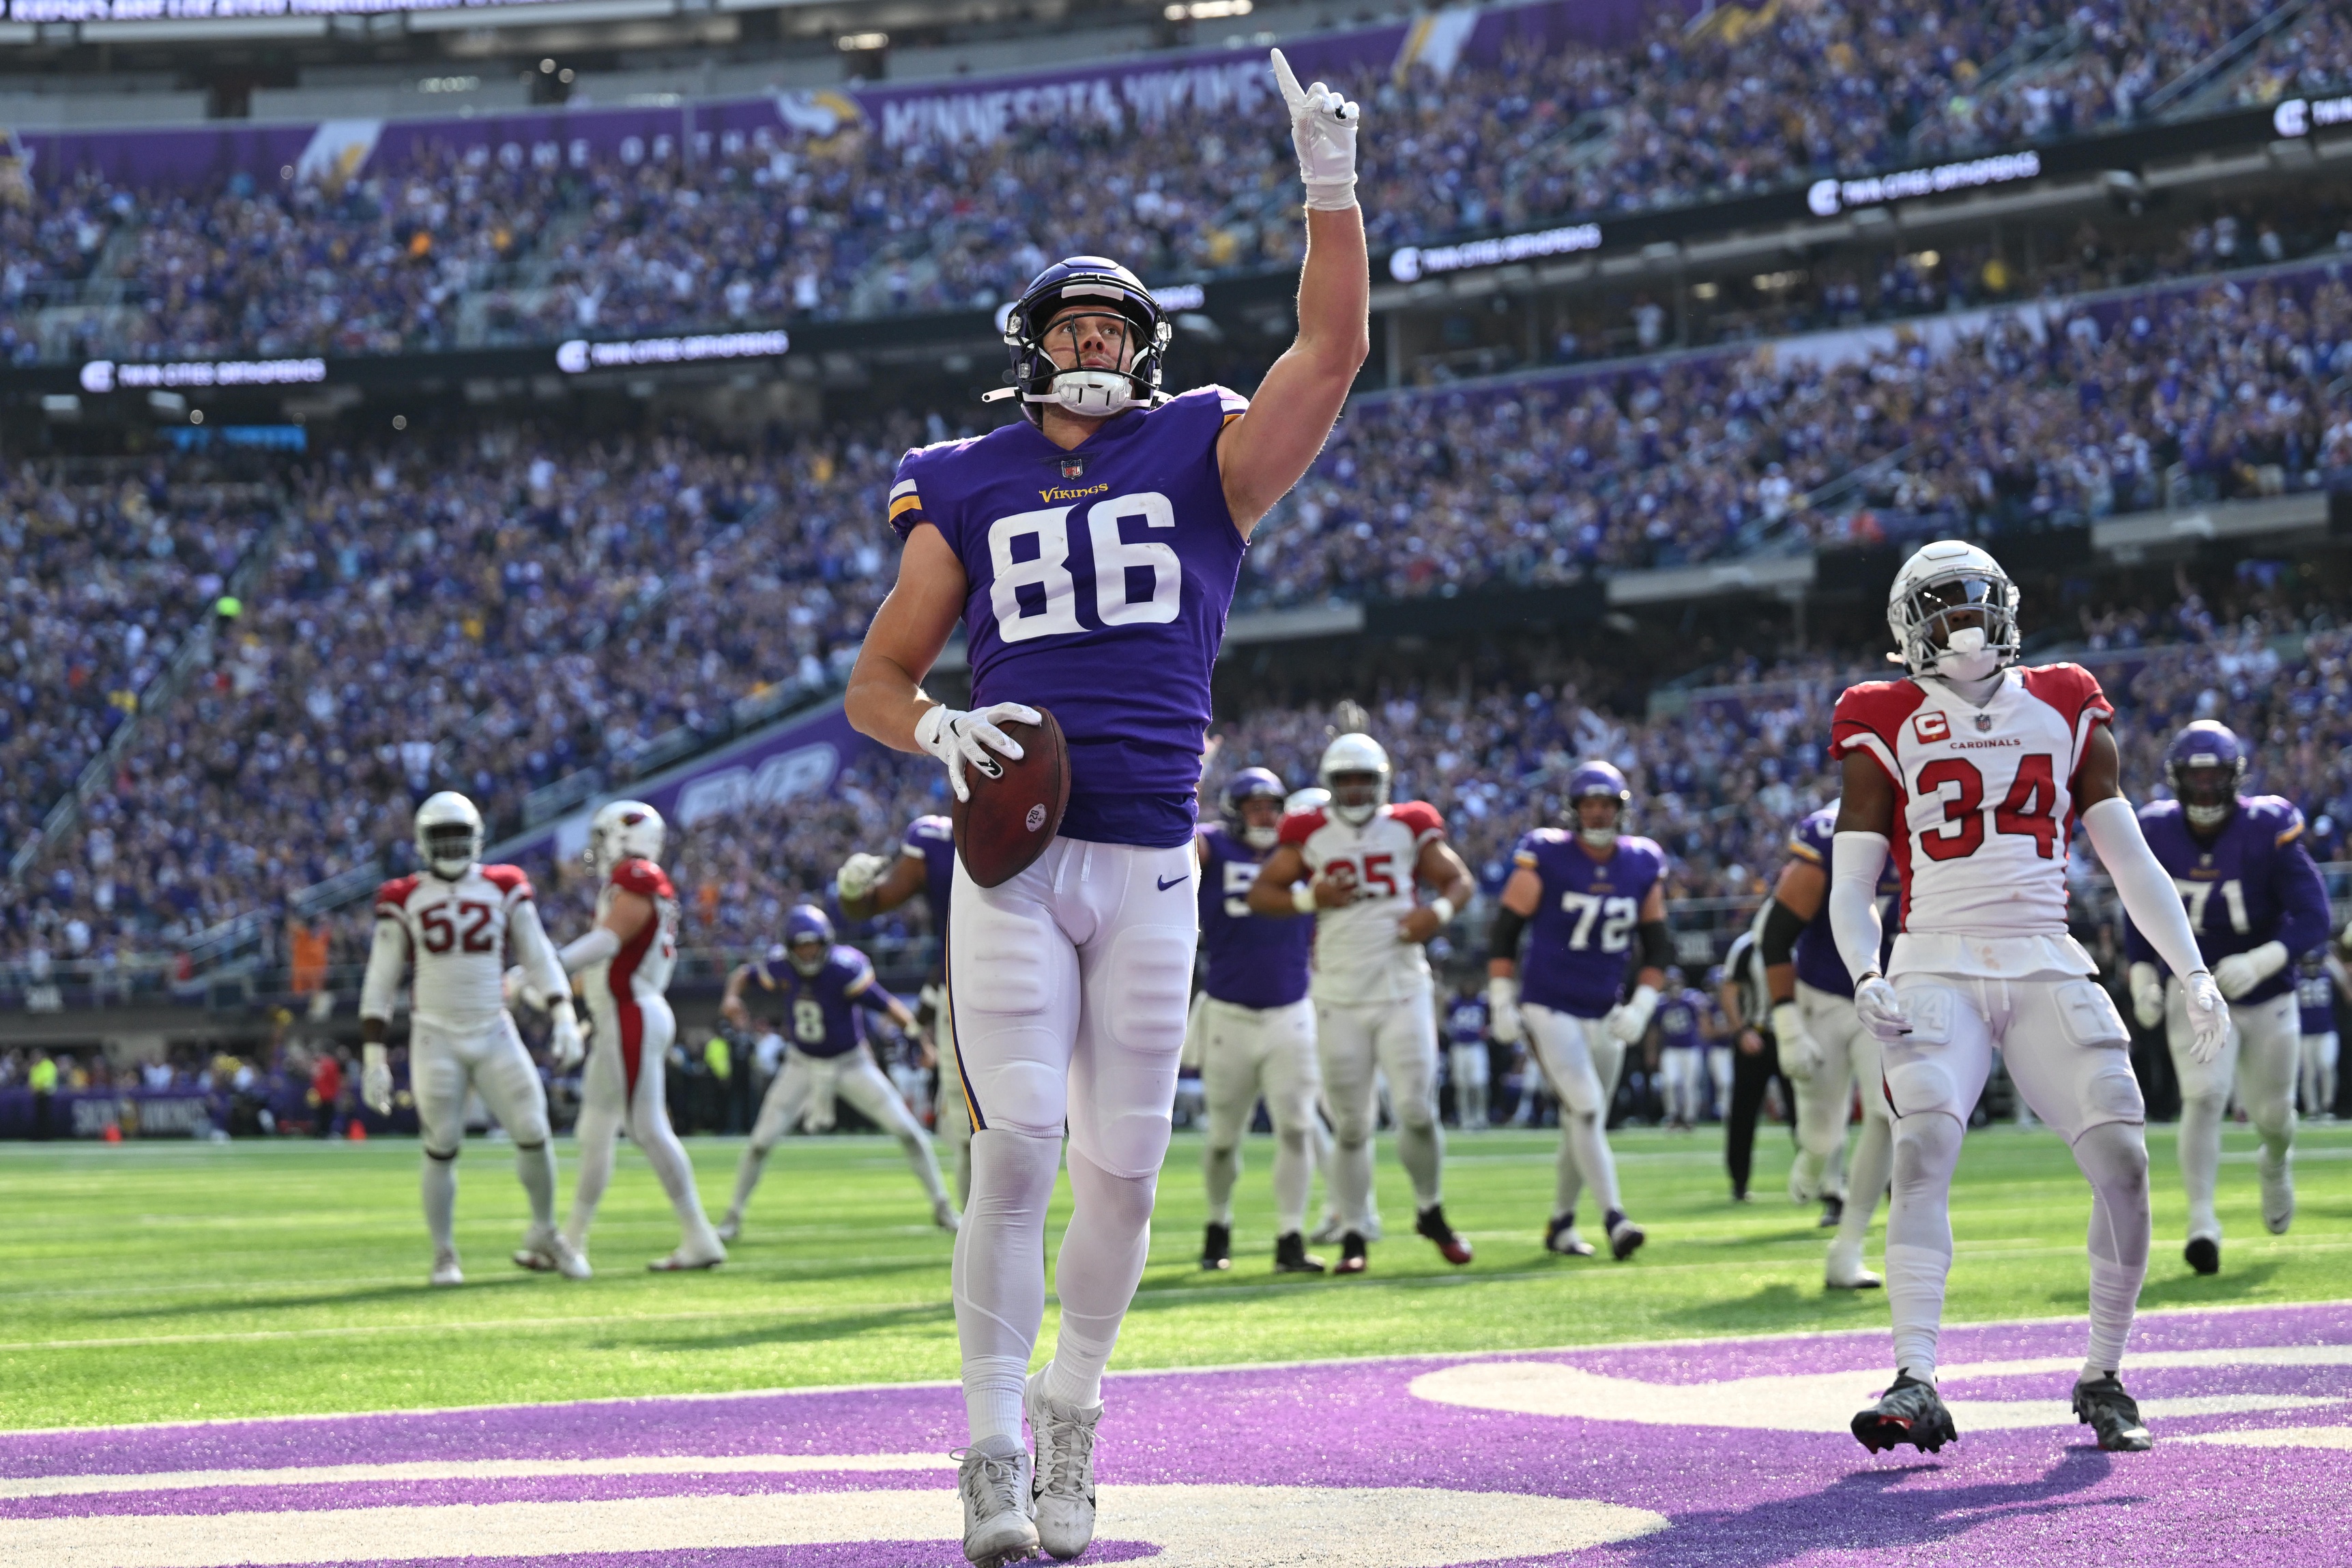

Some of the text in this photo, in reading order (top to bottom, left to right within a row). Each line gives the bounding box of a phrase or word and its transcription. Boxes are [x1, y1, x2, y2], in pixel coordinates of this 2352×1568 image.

[1065, 466, 1080, 476] NFL
[988, 491, 1182, 643] 86
[1915, 712, 1946, 736] C
[1949, 738, 2021, 750] CARDINALS
[1027, 809, 1040, 824] 024
[1916, 753, 2058, 862] 34
[420, 901, 493, 953] 52
[1561, 890, 1638, 953] 72
[2172, 876, 2250, 935] 71
[792, 998, 827, 1045] 8
